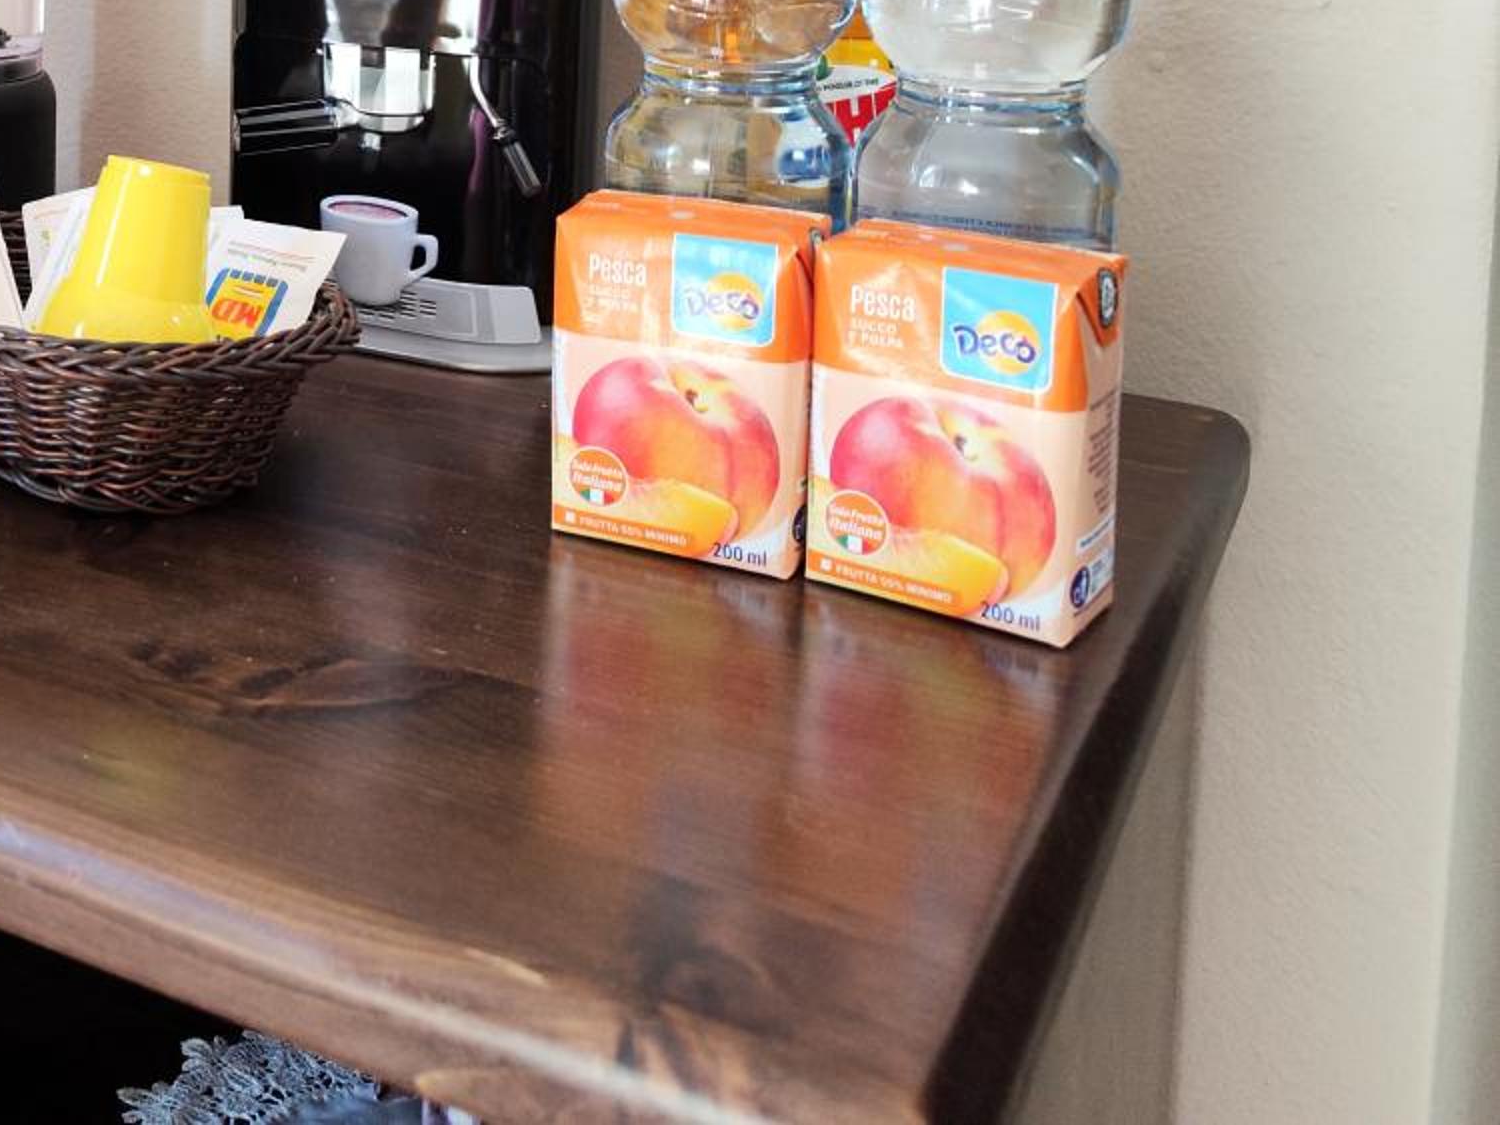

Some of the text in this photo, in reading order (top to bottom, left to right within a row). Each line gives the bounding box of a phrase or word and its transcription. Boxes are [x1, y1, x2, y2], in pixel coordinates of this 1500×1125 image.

[588, 253, 647, 287] Pesca
[684, 287, 760, 321] Deco
[851, 284, 916, 323] Pesca
[953, 325, 1037, 365] Deco
[713, 542, 768, 567] 200 ml
[980, 601, 1041, 632] 200 ml
